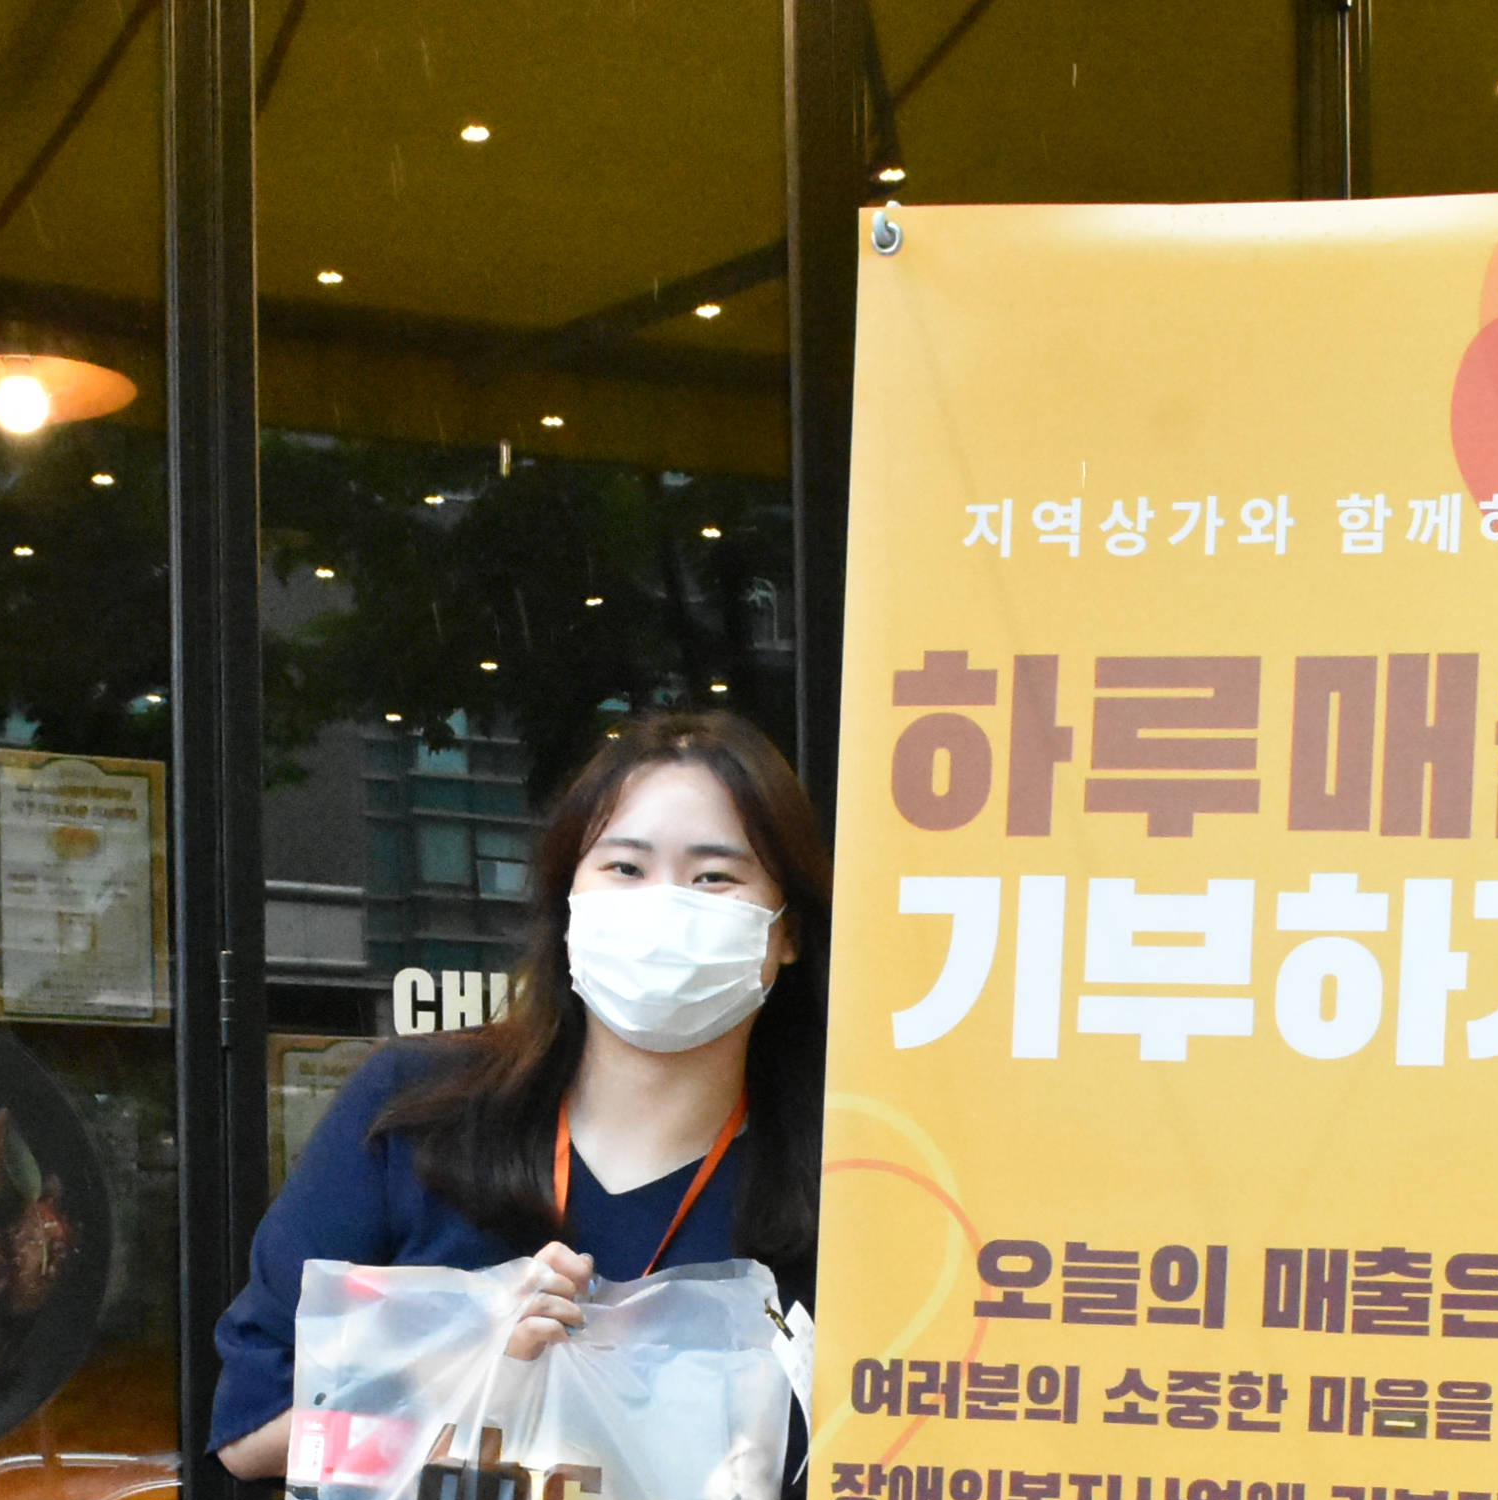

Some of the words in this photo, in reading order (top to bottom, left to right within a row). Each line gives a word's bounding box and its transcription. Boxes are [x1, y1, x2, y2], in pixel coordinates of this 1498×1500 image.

[962, 494, 1295, 558] 지역상가와
[393, 966, 528, 1036] CHI
[973, 1239, 1229, 1330] 오늘의
[850, 1358, 1080, 1424] 여러분의
[1103, 1367, 1288, 1434] 소중한
[1308, 1375, 1494, 1442] 마음을
